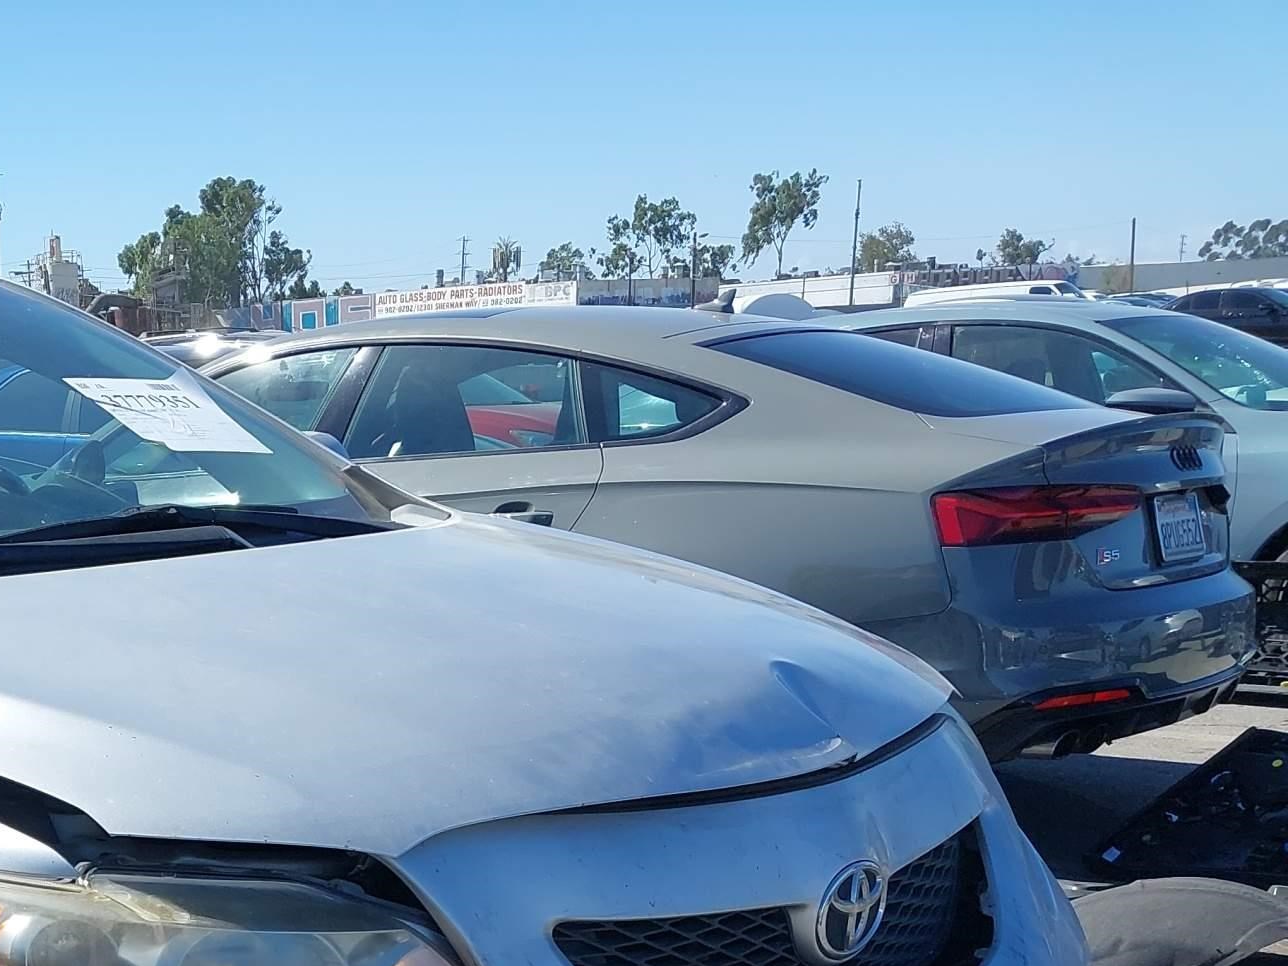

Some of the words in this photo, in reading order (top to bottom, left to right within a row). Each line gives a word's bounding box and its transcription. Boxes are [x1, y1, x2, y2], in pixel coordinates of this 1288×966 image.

[378, 295, 397, 305] AUTO
[400, 290, 447, 304] GLASS-BODY
[450, 284, 523, 299] PARTS-RADIATORS
[100, 394, 201, 409] 37779351
